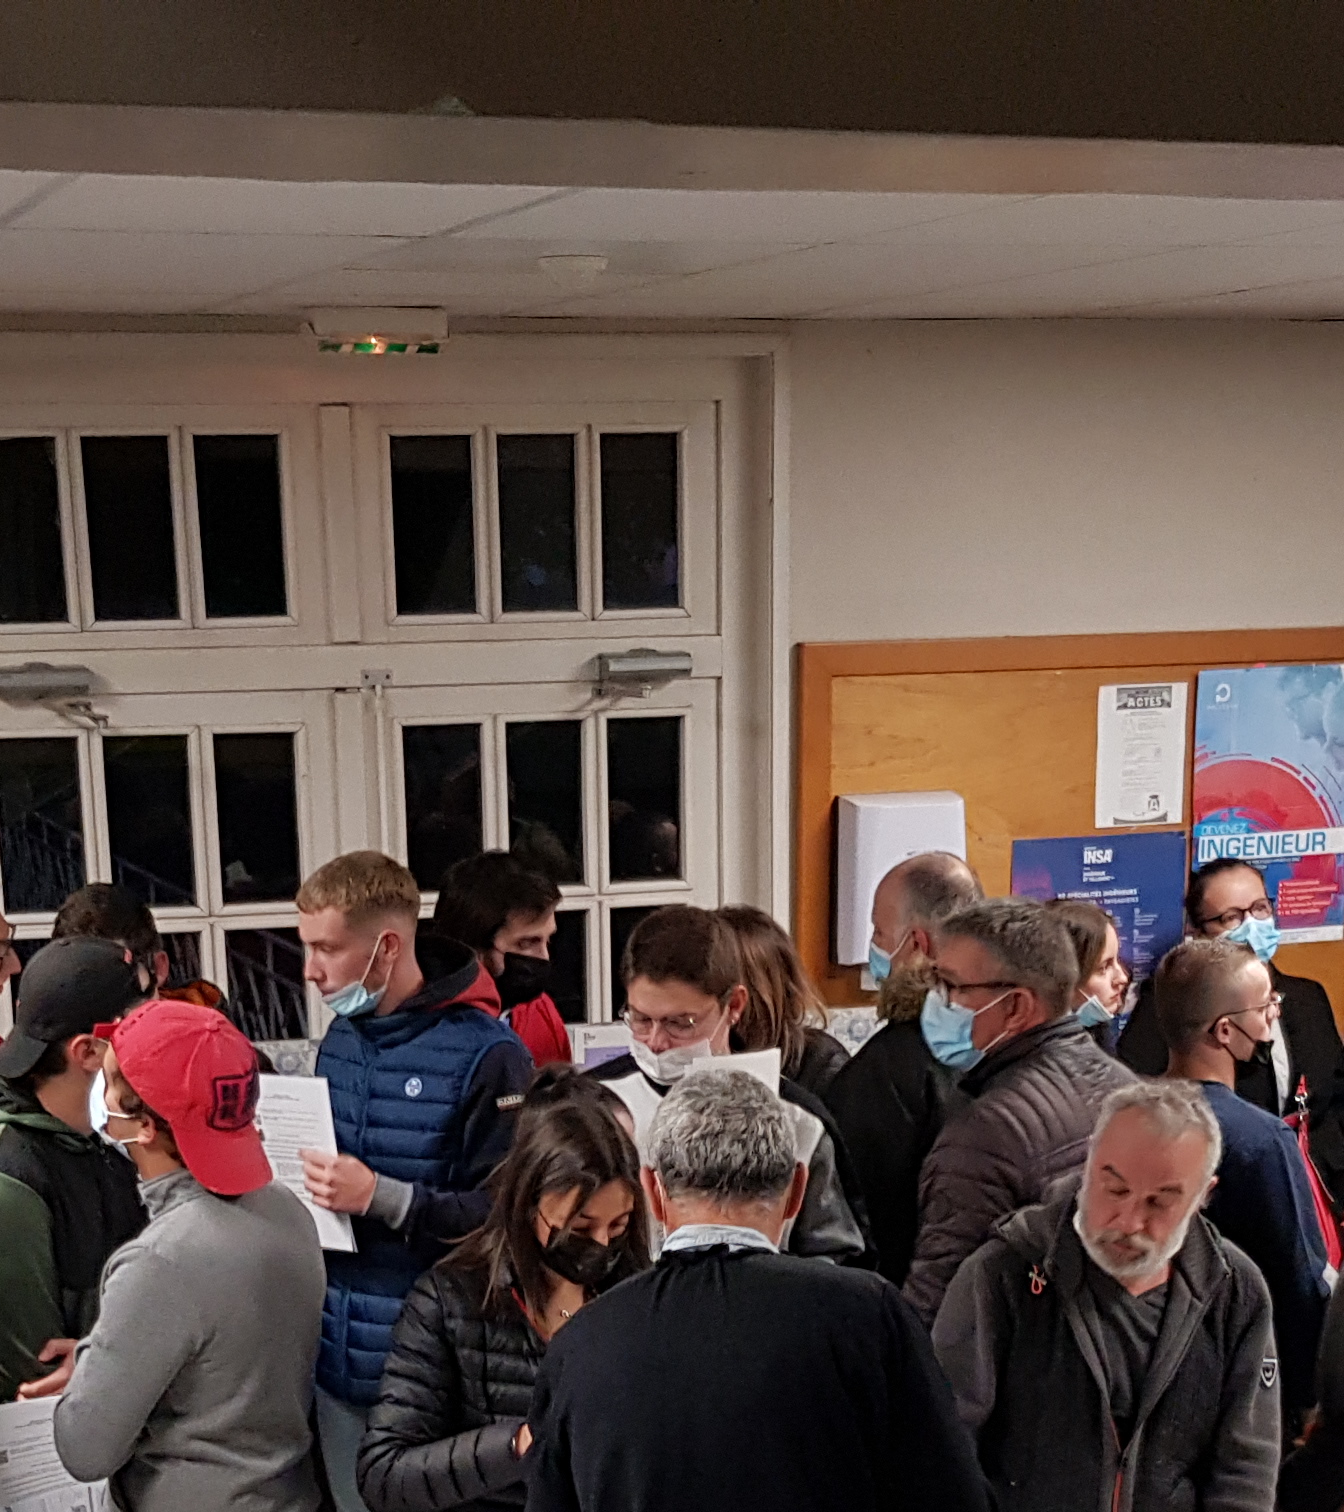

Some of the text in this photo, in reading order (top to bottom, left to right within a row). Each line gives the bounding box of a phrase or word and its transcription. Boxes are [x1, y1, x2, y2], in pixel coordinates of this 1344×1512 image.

[1126, 695, 1164, 709] ACTES
[1201, 824, 1247, 836] DEVENEZ
[1200, 831, 1327, 860] INGENIEUR
[1083, 849, 1114, 865] INSA
